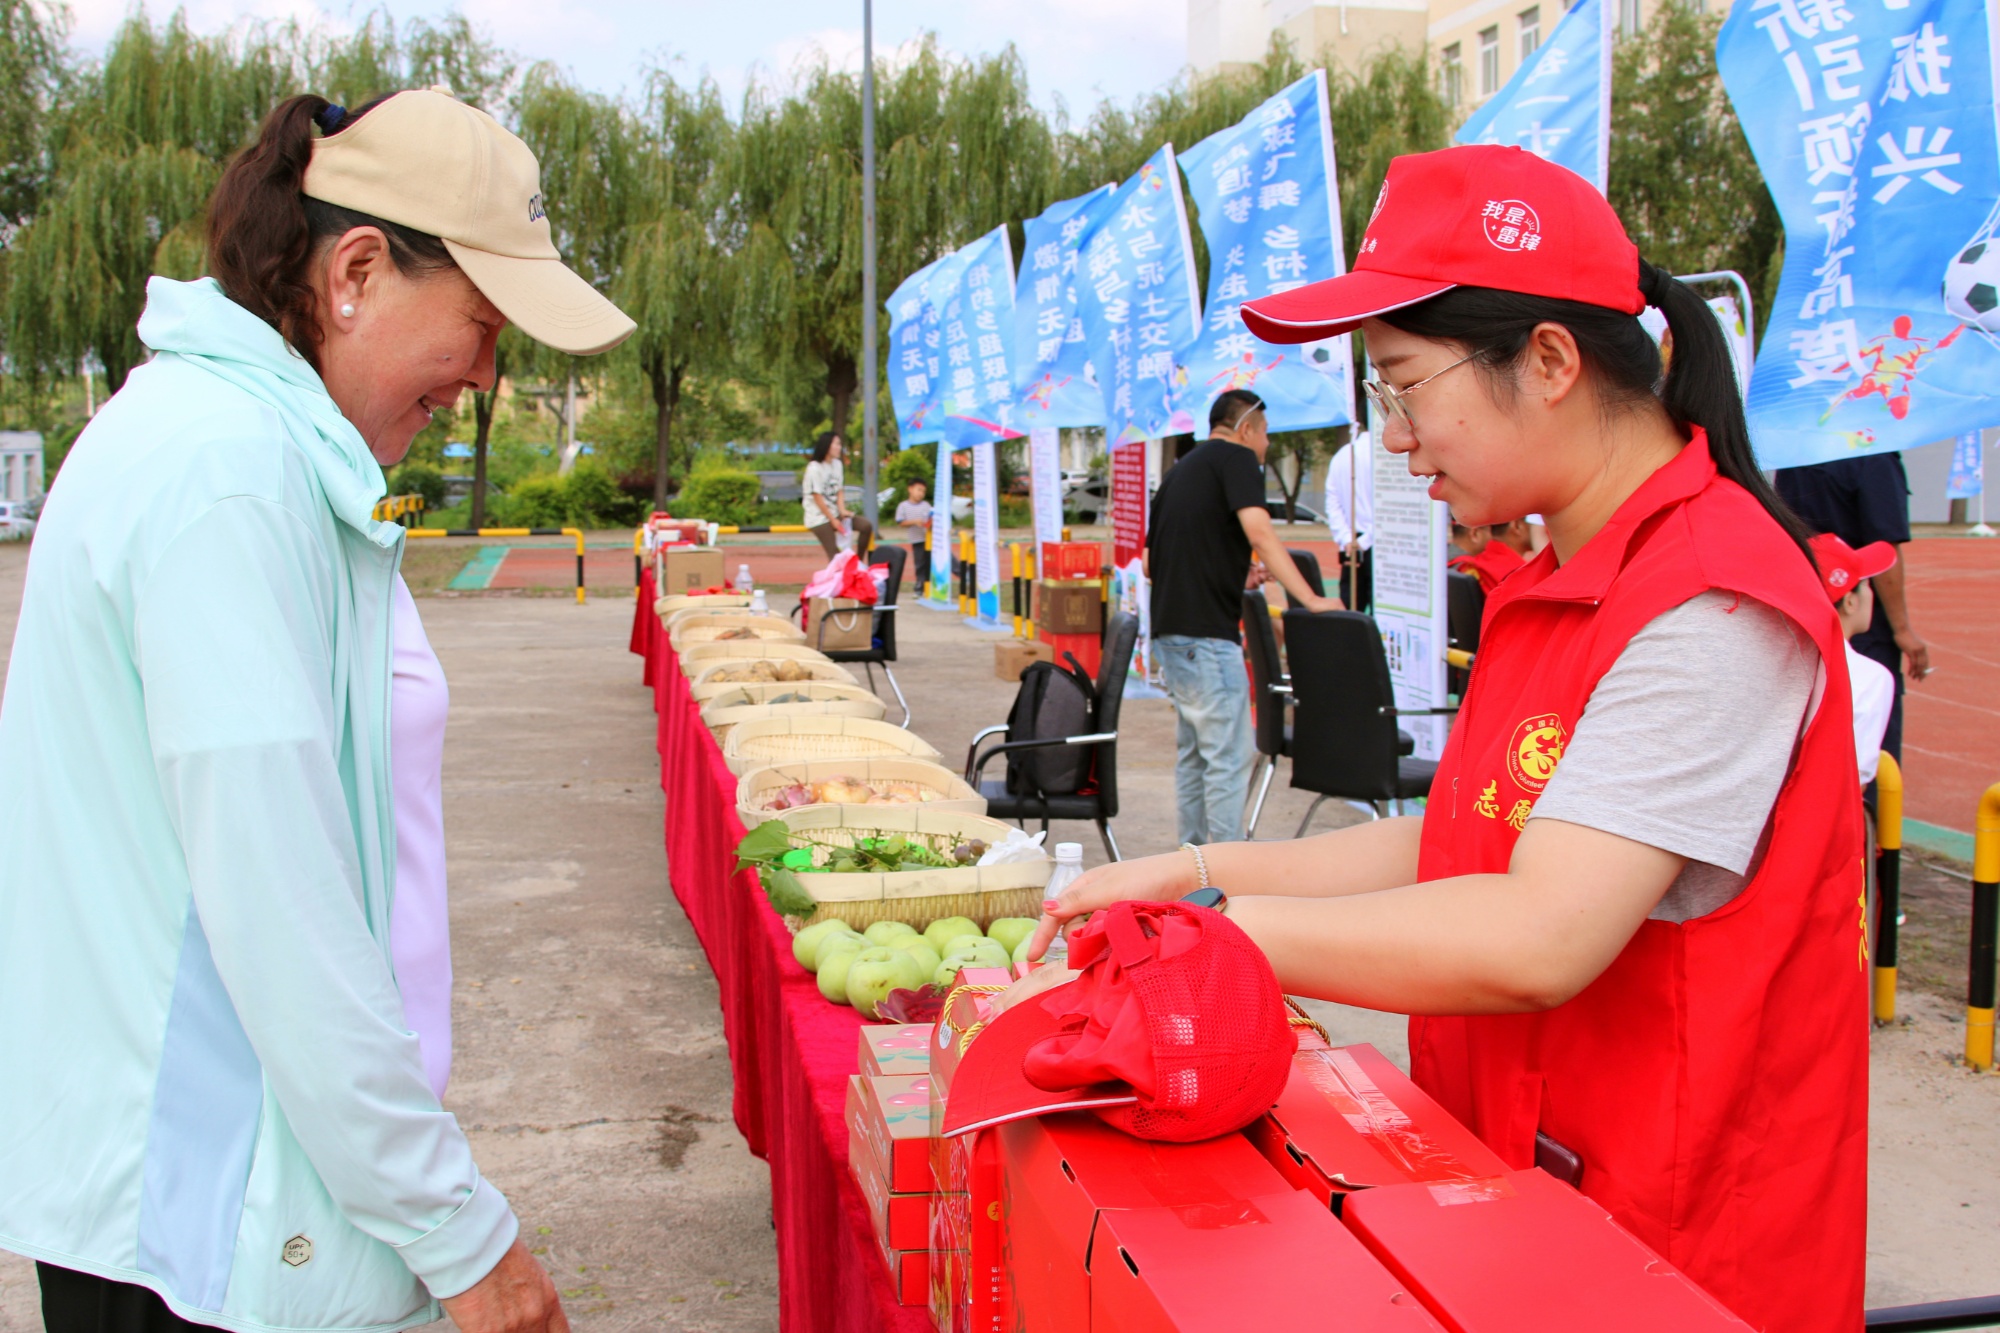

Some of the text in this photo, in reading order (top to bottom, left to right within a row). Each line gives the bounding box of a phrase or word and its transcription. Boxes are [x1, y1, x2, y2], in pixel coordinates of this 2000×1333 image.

[1481, 200, 1526, 226] 我是
[1496, 225, 1542, 251] 雷锋
[1517, 771, 1545, 788] Volunteer
